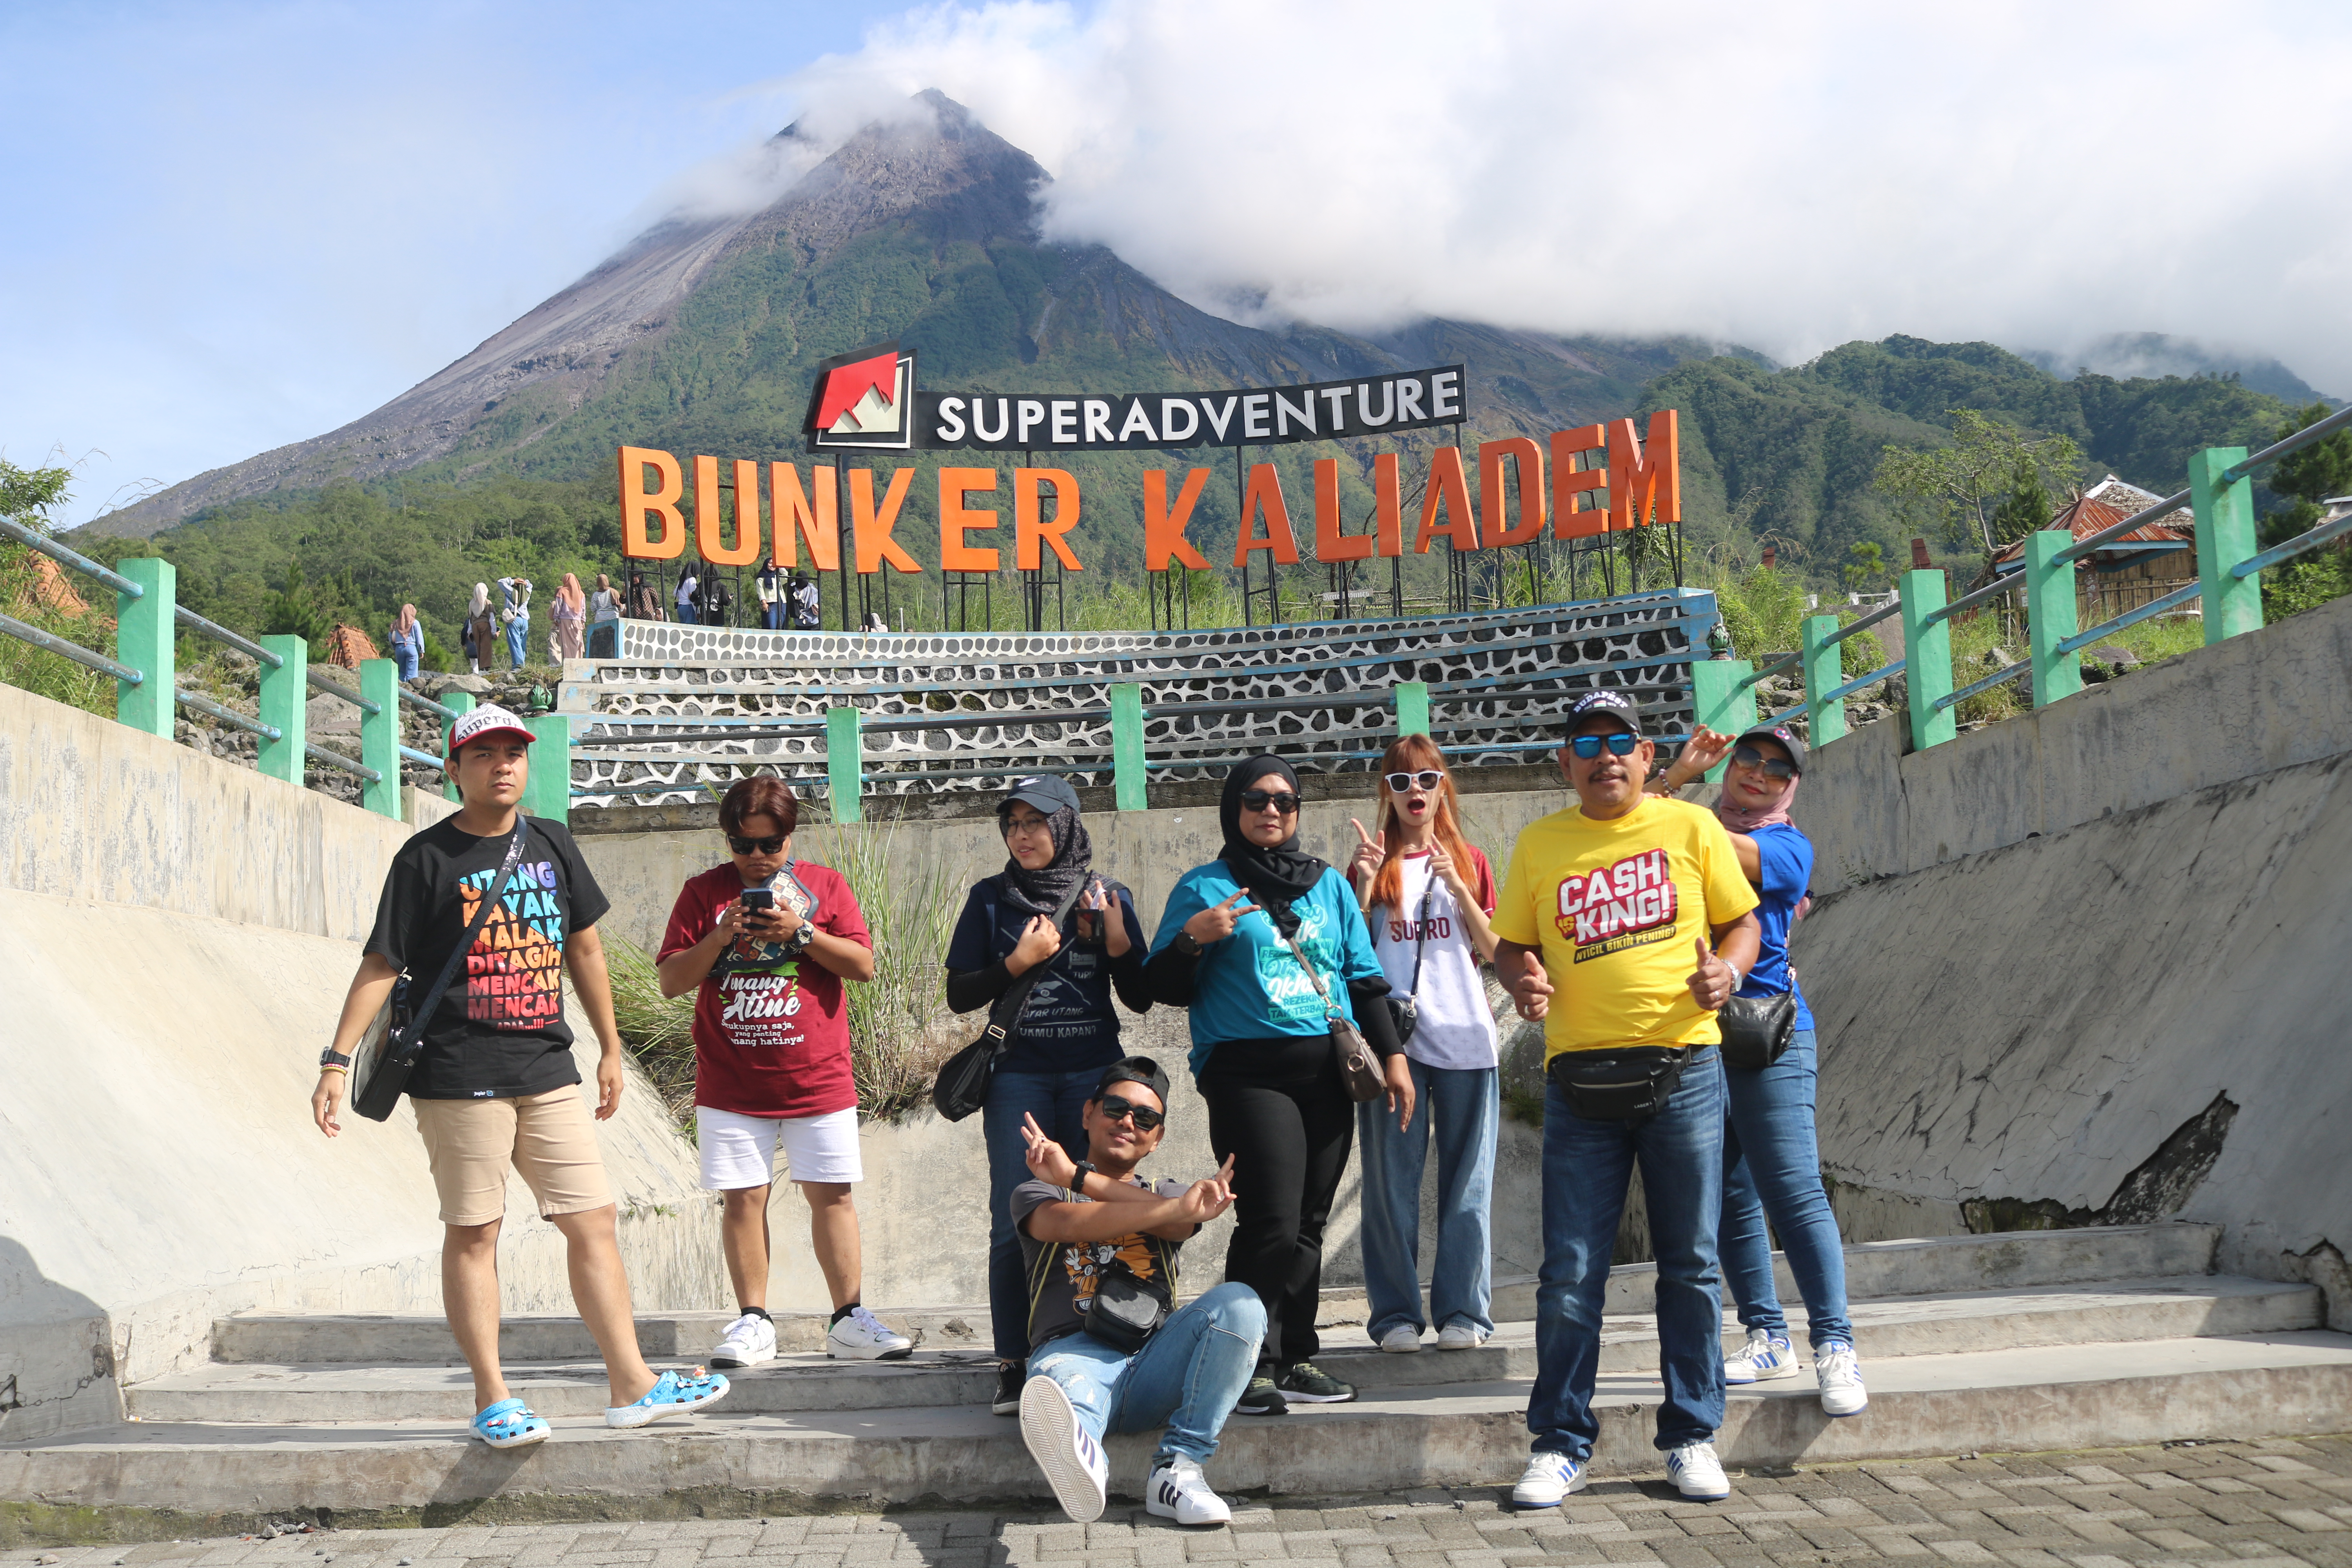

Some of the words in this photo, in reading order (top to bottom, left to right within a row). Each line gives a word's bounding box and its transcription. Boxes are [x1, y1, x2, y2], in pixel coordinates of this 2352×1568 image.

[936, 371, 1460, 443] SUPERADVENTURE
[617, 446, 1083, 574] BUNKER
[1143, 409, 1681, 572] KALIADEM
[1573, 691, 1628, 713] BUDAPEST
[459, 707, 495, 728] World
[459, 861, 556, 900] UTANG
[1560, 851, 1662, 915] CASH
[463, 890, 561, 927] KAYAK
[1558, 916, 1575, 934] IS
[1575, 884, 1670, 943] KING!
[468, 917, 563, 954] MALAK
[1389, 917, 1450, 942] SUPRO
[1576, 945, 1604, 961] NYICIL
[1607, 937, 1633, 952] BIKIN
[1636, 927, 1674, 944] PENING!
[467, 943, 563, 975] DITAGIH
[468, 968, 561, 996] MENCAK
[468, 992, 559, 1019] MENCAK
[723, 991, 801, 1022] Atine
[1052, 1007, 1084, 1016] UTANG
[1270, 1009, 1291, 1018] TAK
[721, 1019, 768, 1032] Sukupnya
[771, 1021, 795, 1031] saja,
[760, 1034, 804, 1045] hatinya!
[1058, 1025, 1096, 1038] KAPAN?
